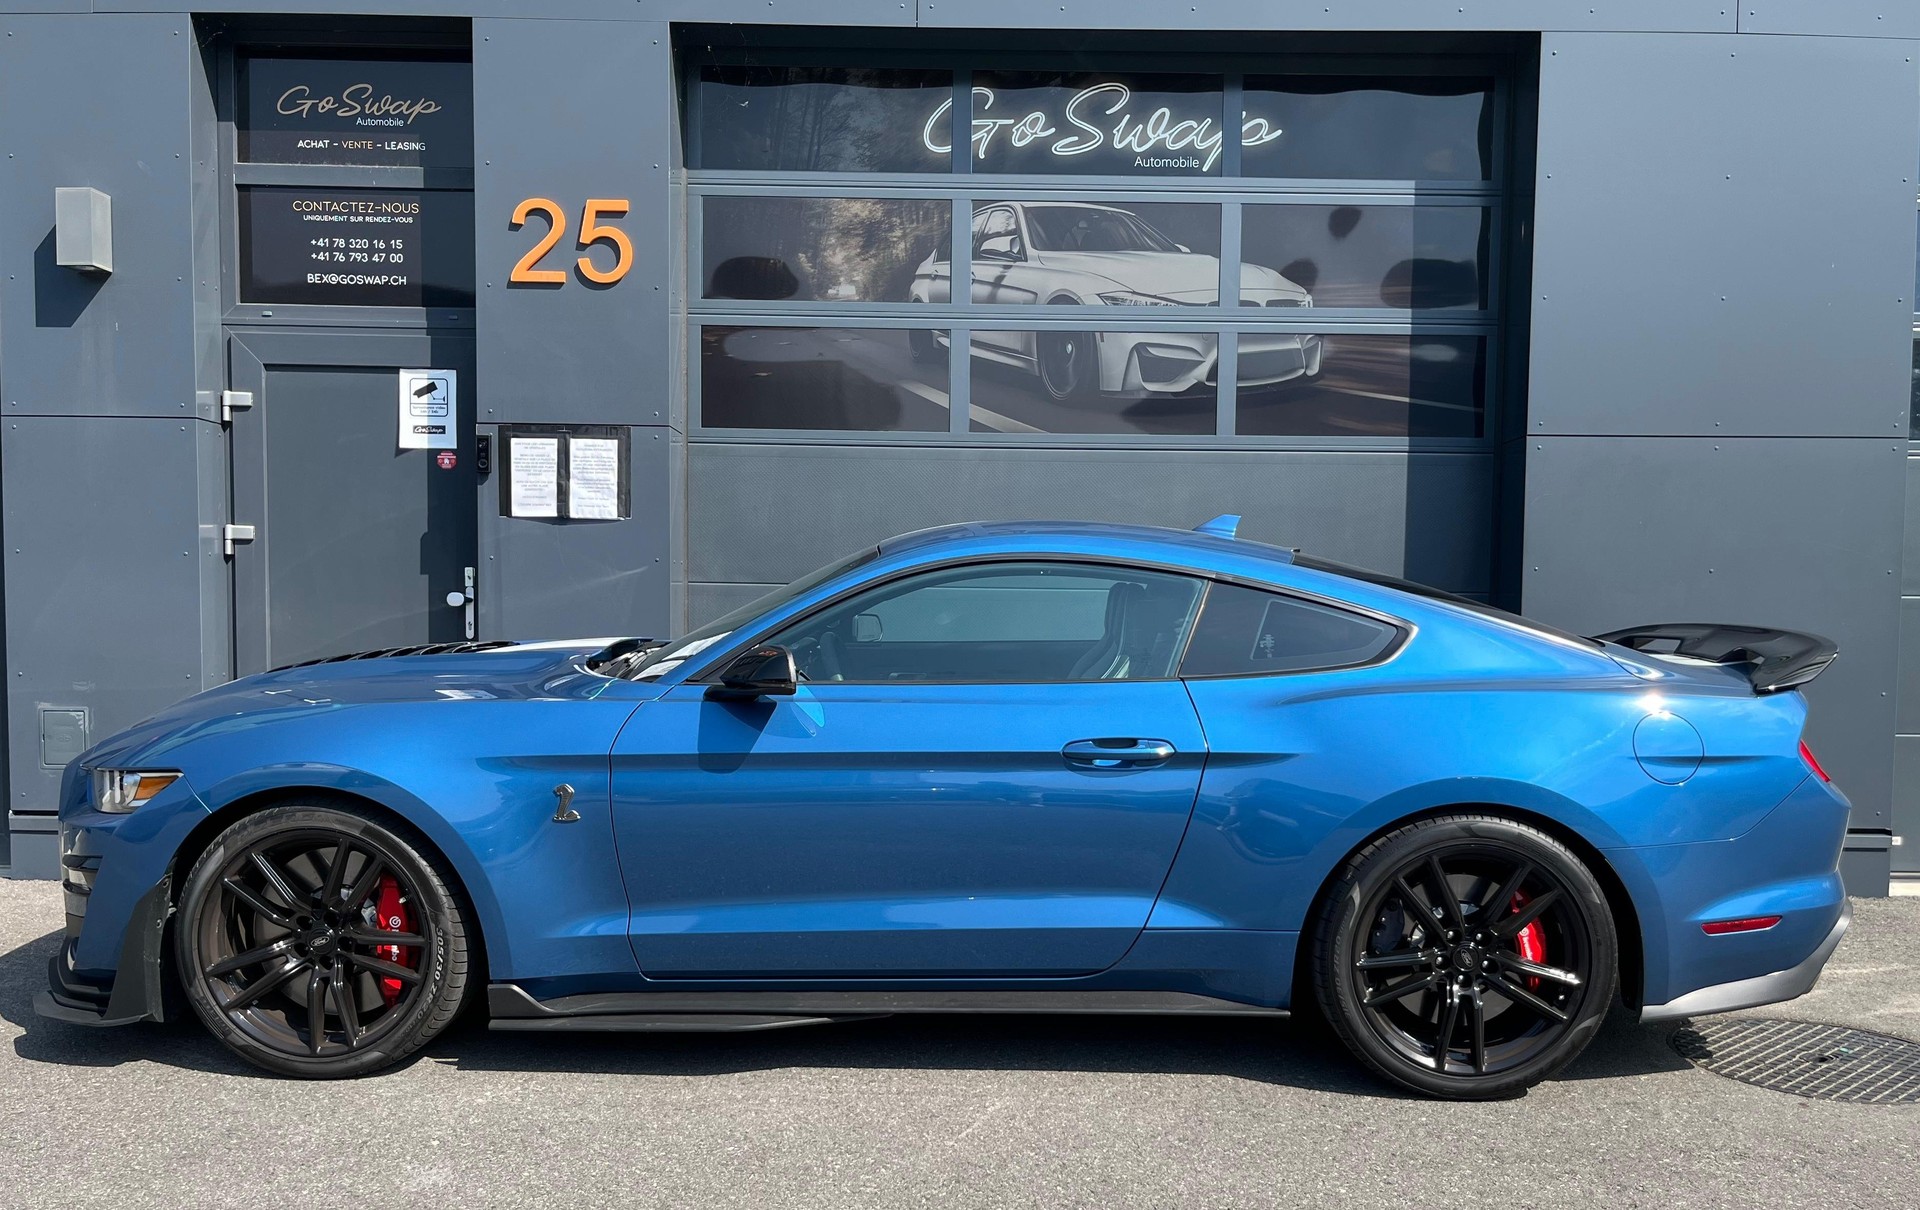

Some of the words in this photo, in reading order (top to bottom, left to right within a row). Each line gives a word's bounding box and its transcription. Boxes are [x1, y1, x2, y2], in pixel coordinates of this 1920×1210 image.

[276, 83, 442, 125] GoSwap
[356, 117, 404, 127] Automobile
[297, 139, 330, 149] ACHAT
[341, 140, 374, 150] VENTE
[385, 141, 426, 151] LEASING
[1134, 155, 1200, 169] Automobile
[292, 200, 420, 214] CONTACTEZ-NOUS
[303, 215, 348, 223] UNIQUEMENT
[310, 238, 330, 248] +41
[332, 238, 346, 248] 78
[349, 239, 369, 249] 320
[372, 239, 386, 249] 16
[389, 240, 403, 249] 15
[509, 198, 633, 284] 25
[311, 252, 330, 262] +41
[332, 252, 346, 262] 76
[349, 253, 369, 262] 793
[372, 253, 386, 263] 47
[389, 253, 404, 263] 00
[307, 273, 407, 286] BEX@GOSWAP.CH
[435, 926, 445, 981] 305/30
